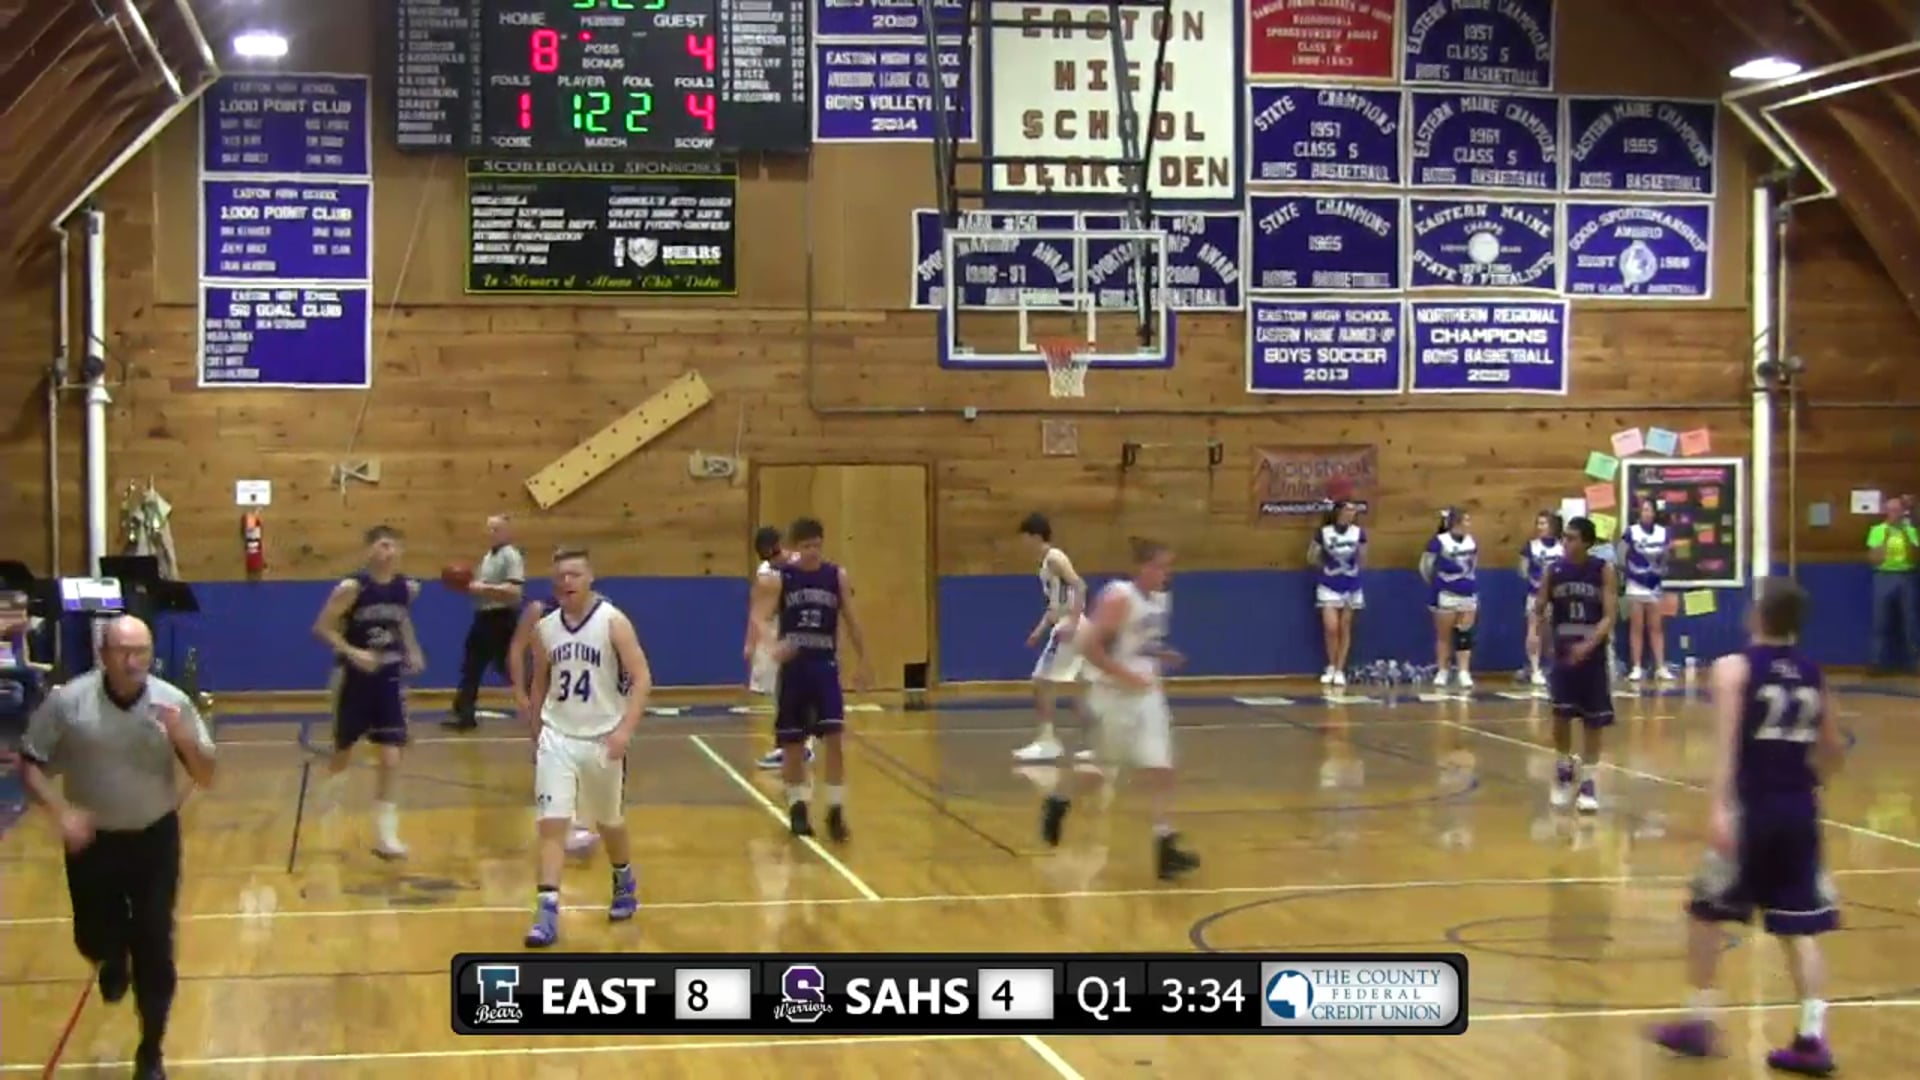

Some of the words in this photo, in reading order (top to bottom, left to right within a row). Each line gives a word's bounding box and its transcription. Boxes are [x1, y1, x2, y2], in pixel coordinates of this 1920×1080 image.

[500, 12, 546, 26] HOME
[653, 14, 708, 28] GUEST
[530, 29, 559, 73] 8
[687, 34, 715, 72] 4
[1446, 44, 1488, 61] CLASS
[558, 75, 605, 87] PLAYER
[622, 76, 654, 87] FOUL
[674, 76, 715, 88] FOULS
[264, 101, 307, 113] POINT
[313, 102, 352, 114] CLUB
[519, 93, 531, 129] 1
[573, 92, 611, 132] 12
[626, 92, 651, 132] 2
[687, 93, 715, 131] 4
[1254, 96, 1296, 132] STATE
[1293, 142, 1337, 158] CLASS
[1348, 143, 1359, 159] S
[1453, 147, 1495, 164] CLASS
[1506, 150, 1518, 165] S
[484, 161, 614, 174] SCOREBOARD
[624, 161, 721, 174] SPONSORS
[1160, 156, 1229, 187] DEN
[264, 206, 308, 219] POINT
[312, 207, 352, 221] CLUB
[1259, 202, 1300, 235] STATE
[1414, 203, 1488, 236] EASTERN
[1501, 205, 1551, 238] MAINE
[1413, 250, 1457, 282] STATE
[302, 304, 342, 317] CLUB
[1257, 309, 1307, 322] EASTON
[1345, 310, 1393, 323] SCHOOL
[1493, 308, 1559, 324] REGIONAL
[1430, 328, 1548, 344] CHAMPIONS
[1264, 348, 1312, 363] BOYS
[1317, 348, 1387, 363] SOCCER
[1464, 348, 1554, 364] BASKETBALL
[1304, 369, 1349, 381] 2013
[557, 669, 592, 702] 34
[1754, 684, 1819, 742] 22
